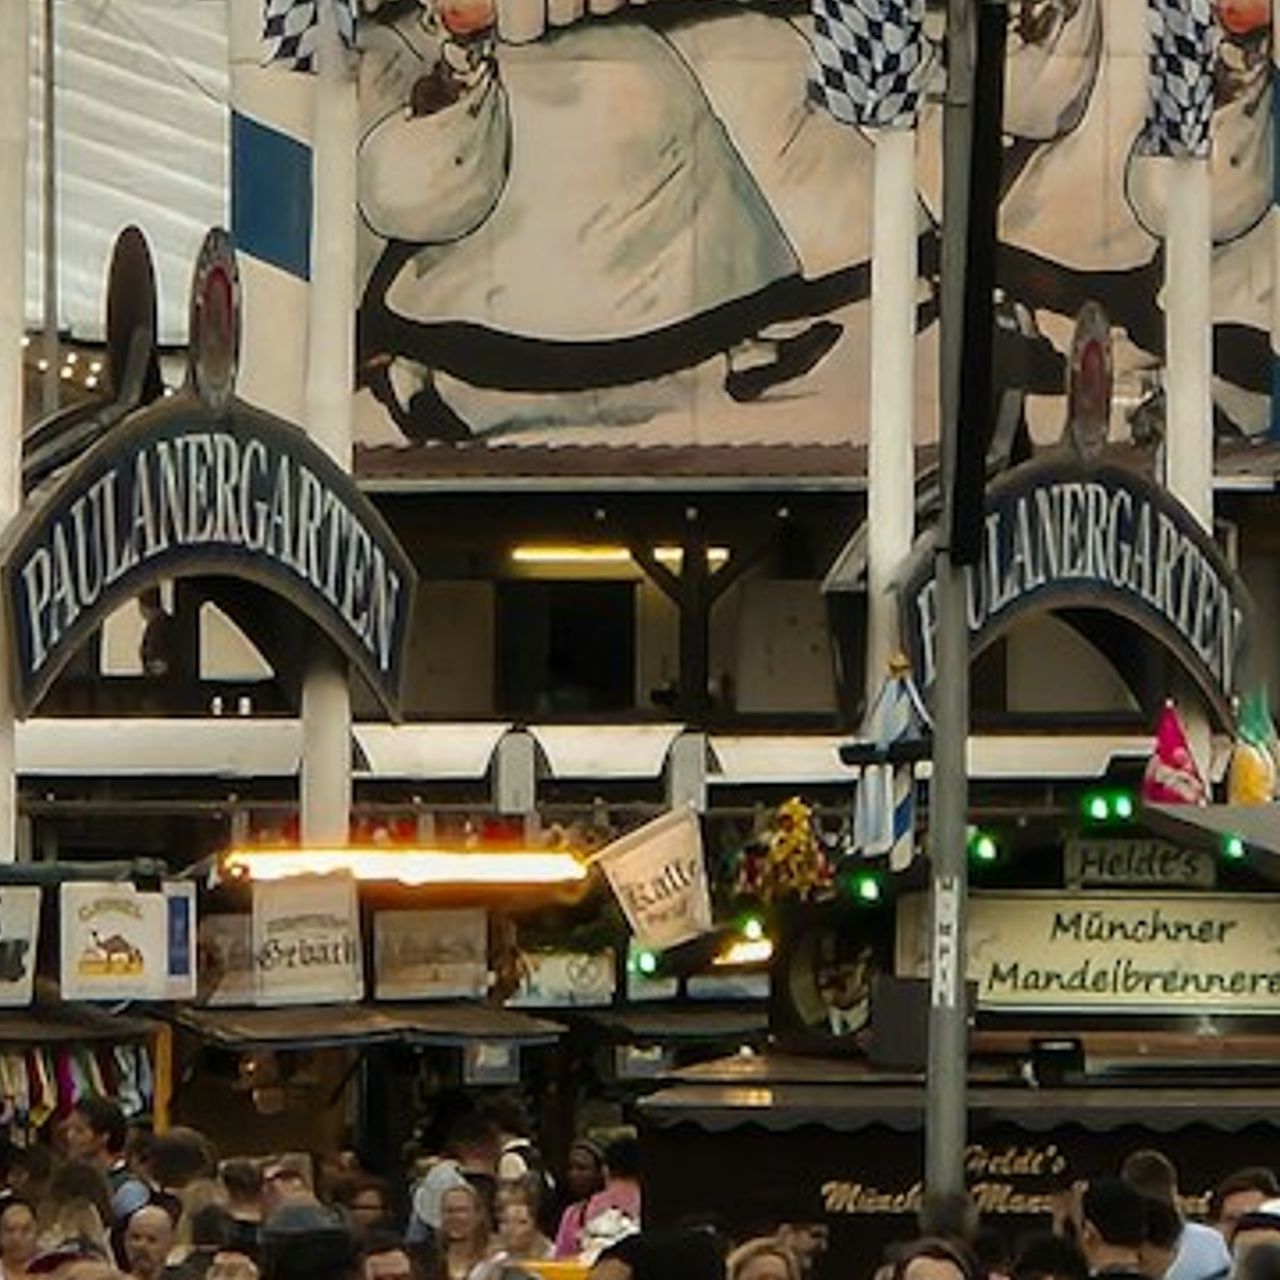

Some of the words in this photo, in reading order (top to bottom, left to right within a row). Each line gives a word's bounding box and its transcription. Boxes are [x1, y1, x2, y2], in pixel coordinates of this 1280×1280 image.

[22, 432, 401, 672] PAULANERGARTEN
[917, 483, 1243, 697] PULANERGARTEN
[1050, 909, 1237, 944] Münchner
